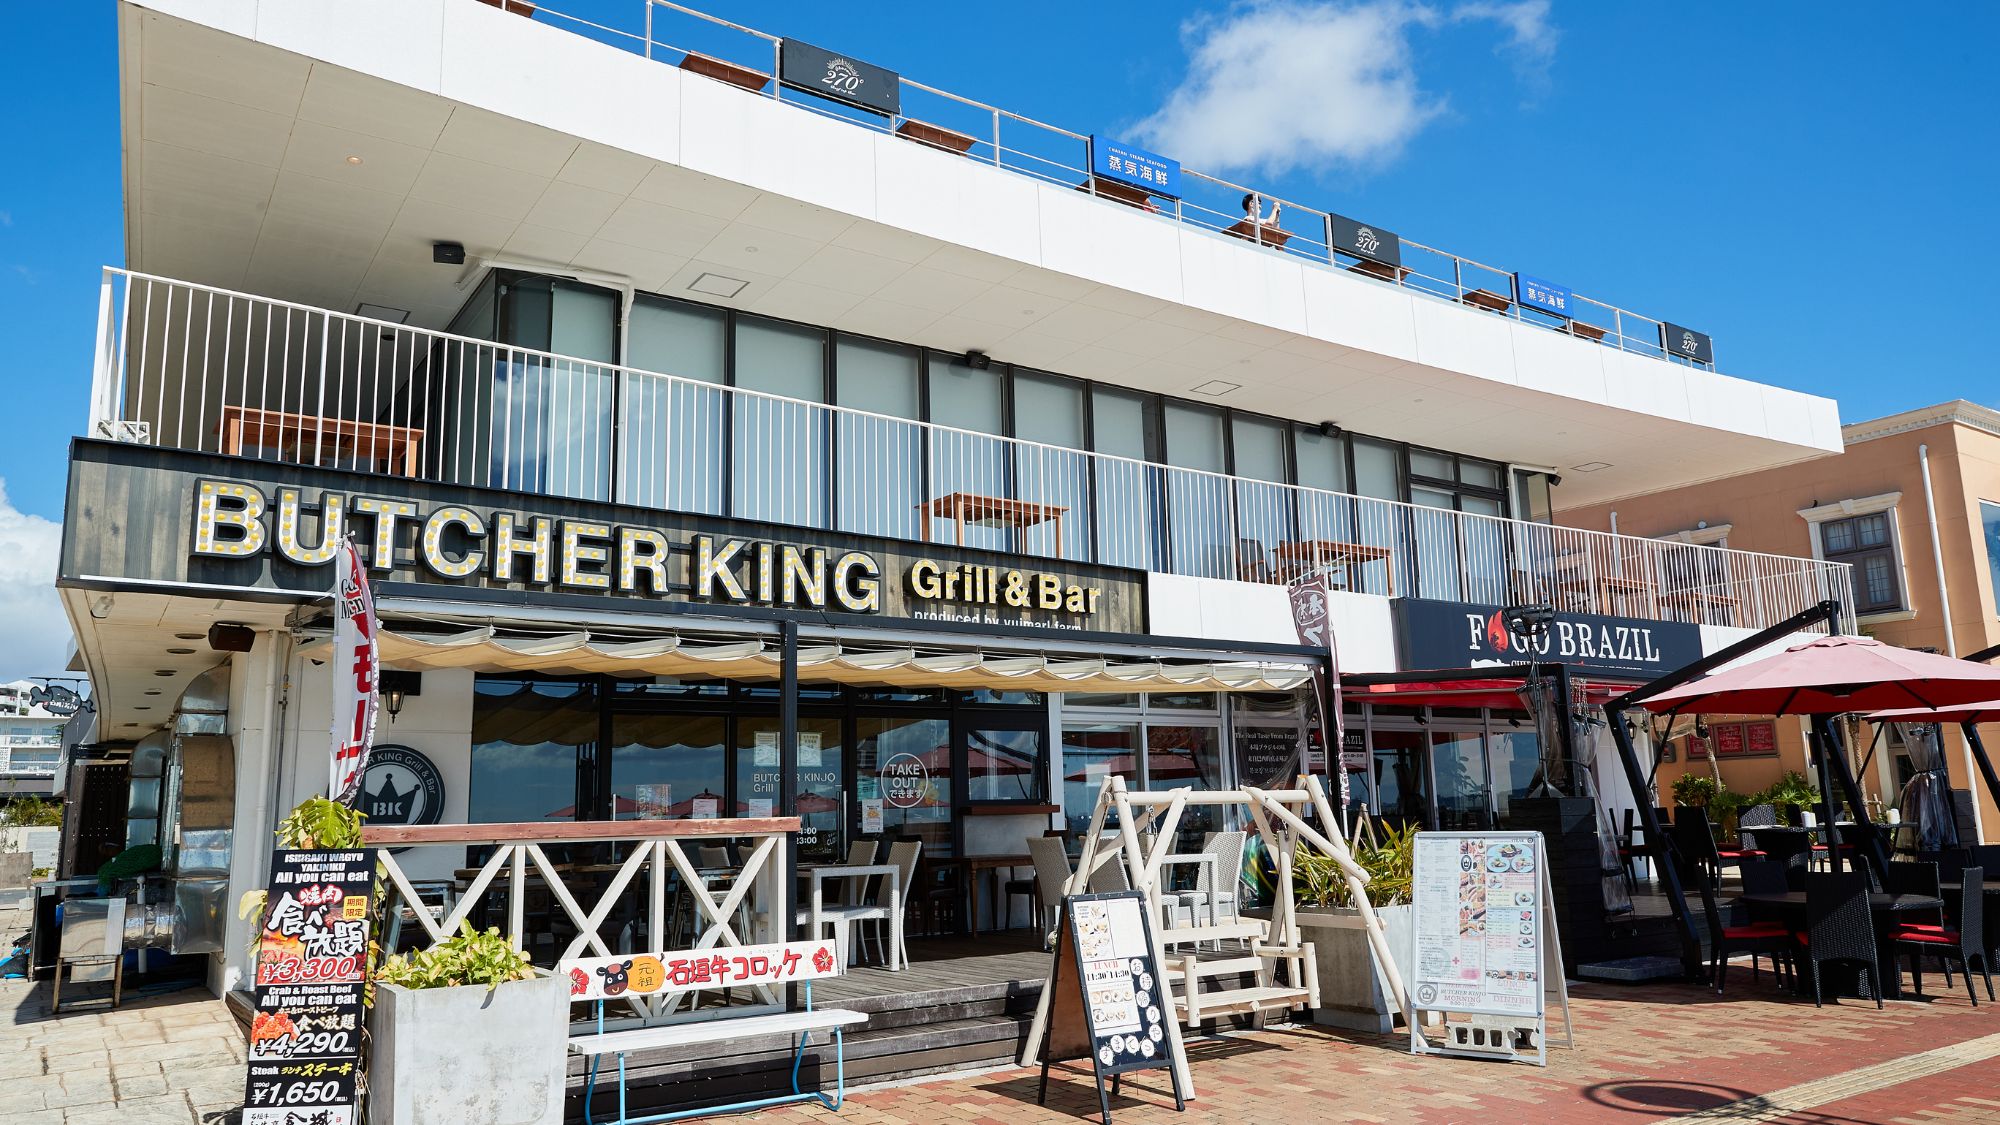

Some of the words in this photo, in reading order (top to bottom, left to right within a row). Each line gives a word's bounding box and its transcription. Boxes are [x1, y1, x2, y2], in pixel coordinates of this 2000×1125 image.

[1109, 155, 1168, 186] 蒸気海鮮
[194, 478, 670, 595] BUTCHER
[692, 534, 880, 614] KING
[910, 558, 996, 606] Grill
[1037, 573, 1102, 615] Bar
[1556, 621, 1660, 662] BRAZIL
[377, 752, 403, 762] KING
[405, 756, 424, 773] Grill
[426, 777, 436, 794] Bar
[754, 773, 800, 782] BUTCR
[804, 773, 836, 782] KINJO
[889, 764, 920, 776] TAKE
[754, 784, 774, 793] Grill
[892, 777, 918, 788] OUT
[889, 789, 922, 799] できます
[285, 854, 326, 863] ISHIGAKI
[329, 852, 364, 862] WAGYU
[301, 863, 346, 872] YAKINIKU
[275, 872, 293, 884] All
[294, 874, 319, 884] you
[321, 873, 345, 882] can
[347, 871, 370, 882] eat
[300, 884, 343, 905] 焼肉
[345, 908, 364, 917] 限定
[264, 957, 357, 980] ¥3,300
[637, 963, 655, 987] 元祖
[666, 949, 803, 985] 石垣牛コロッケ
[269, 986, 291, 996] Crab
[292, 986, 300, 994] &
[301, 986, 328, 994] Roast
[330, 984, 352, 993] Beef
[261, 995, 279, 1006] All
[280, 996, 306, 1008] you
[308, 996, 333, 1006] can
[335, 994, 358, 1004] eat
[296, 1013, 356, 1031] 食べ放題
[256, 1032, 348, 1058] ¥4,290
[252, 1066, 279, 1076] Steak
[251, 1080, 340, 1106] ¥1,650
